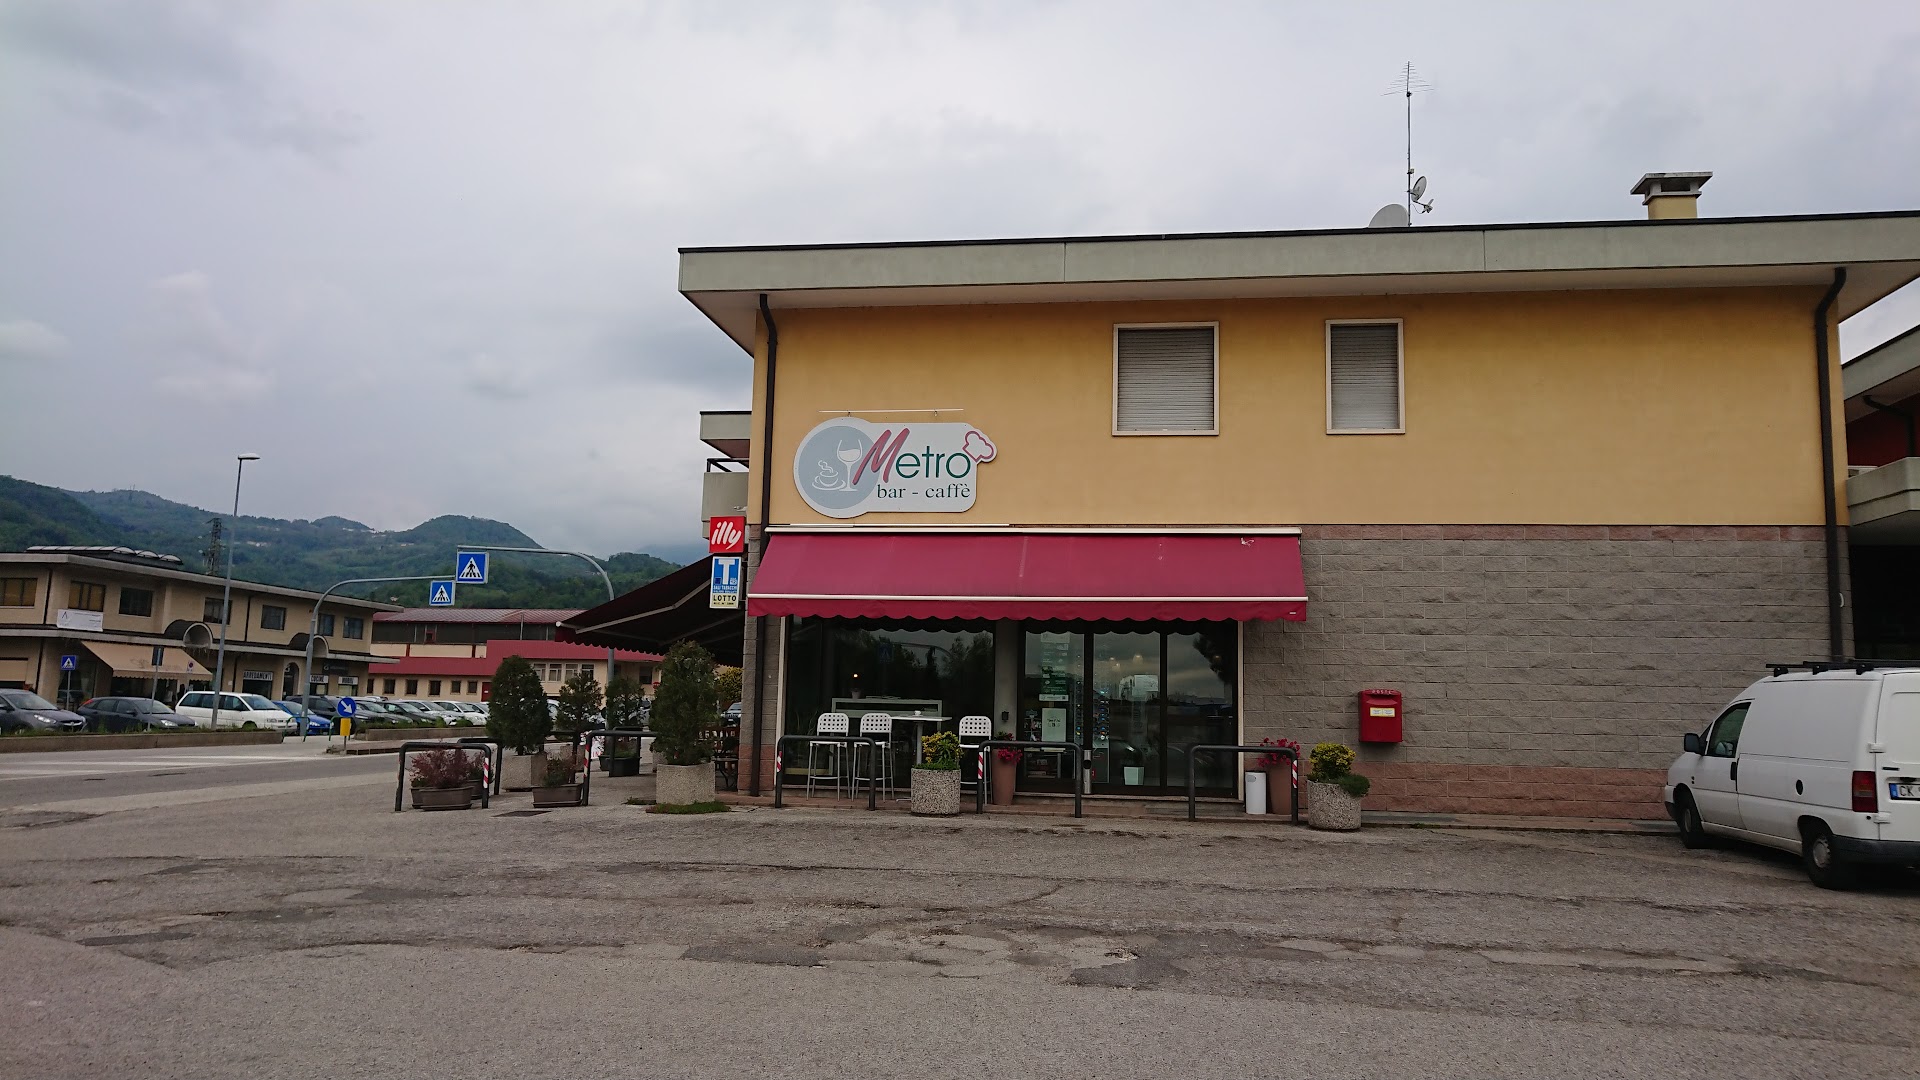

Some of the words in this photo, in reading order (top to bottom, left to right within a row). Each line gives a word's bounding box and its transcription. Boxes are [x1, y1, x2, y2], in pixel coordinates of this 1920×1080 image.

[852, 428, 971, 485] Metro
[877, 484, 906, 499] bar
[925, 483, 971, 499] caffè
[711, 520, 742, 550] illy
[718, 559, 735, 585] T
[1899, 785, 1914, 797] CK
